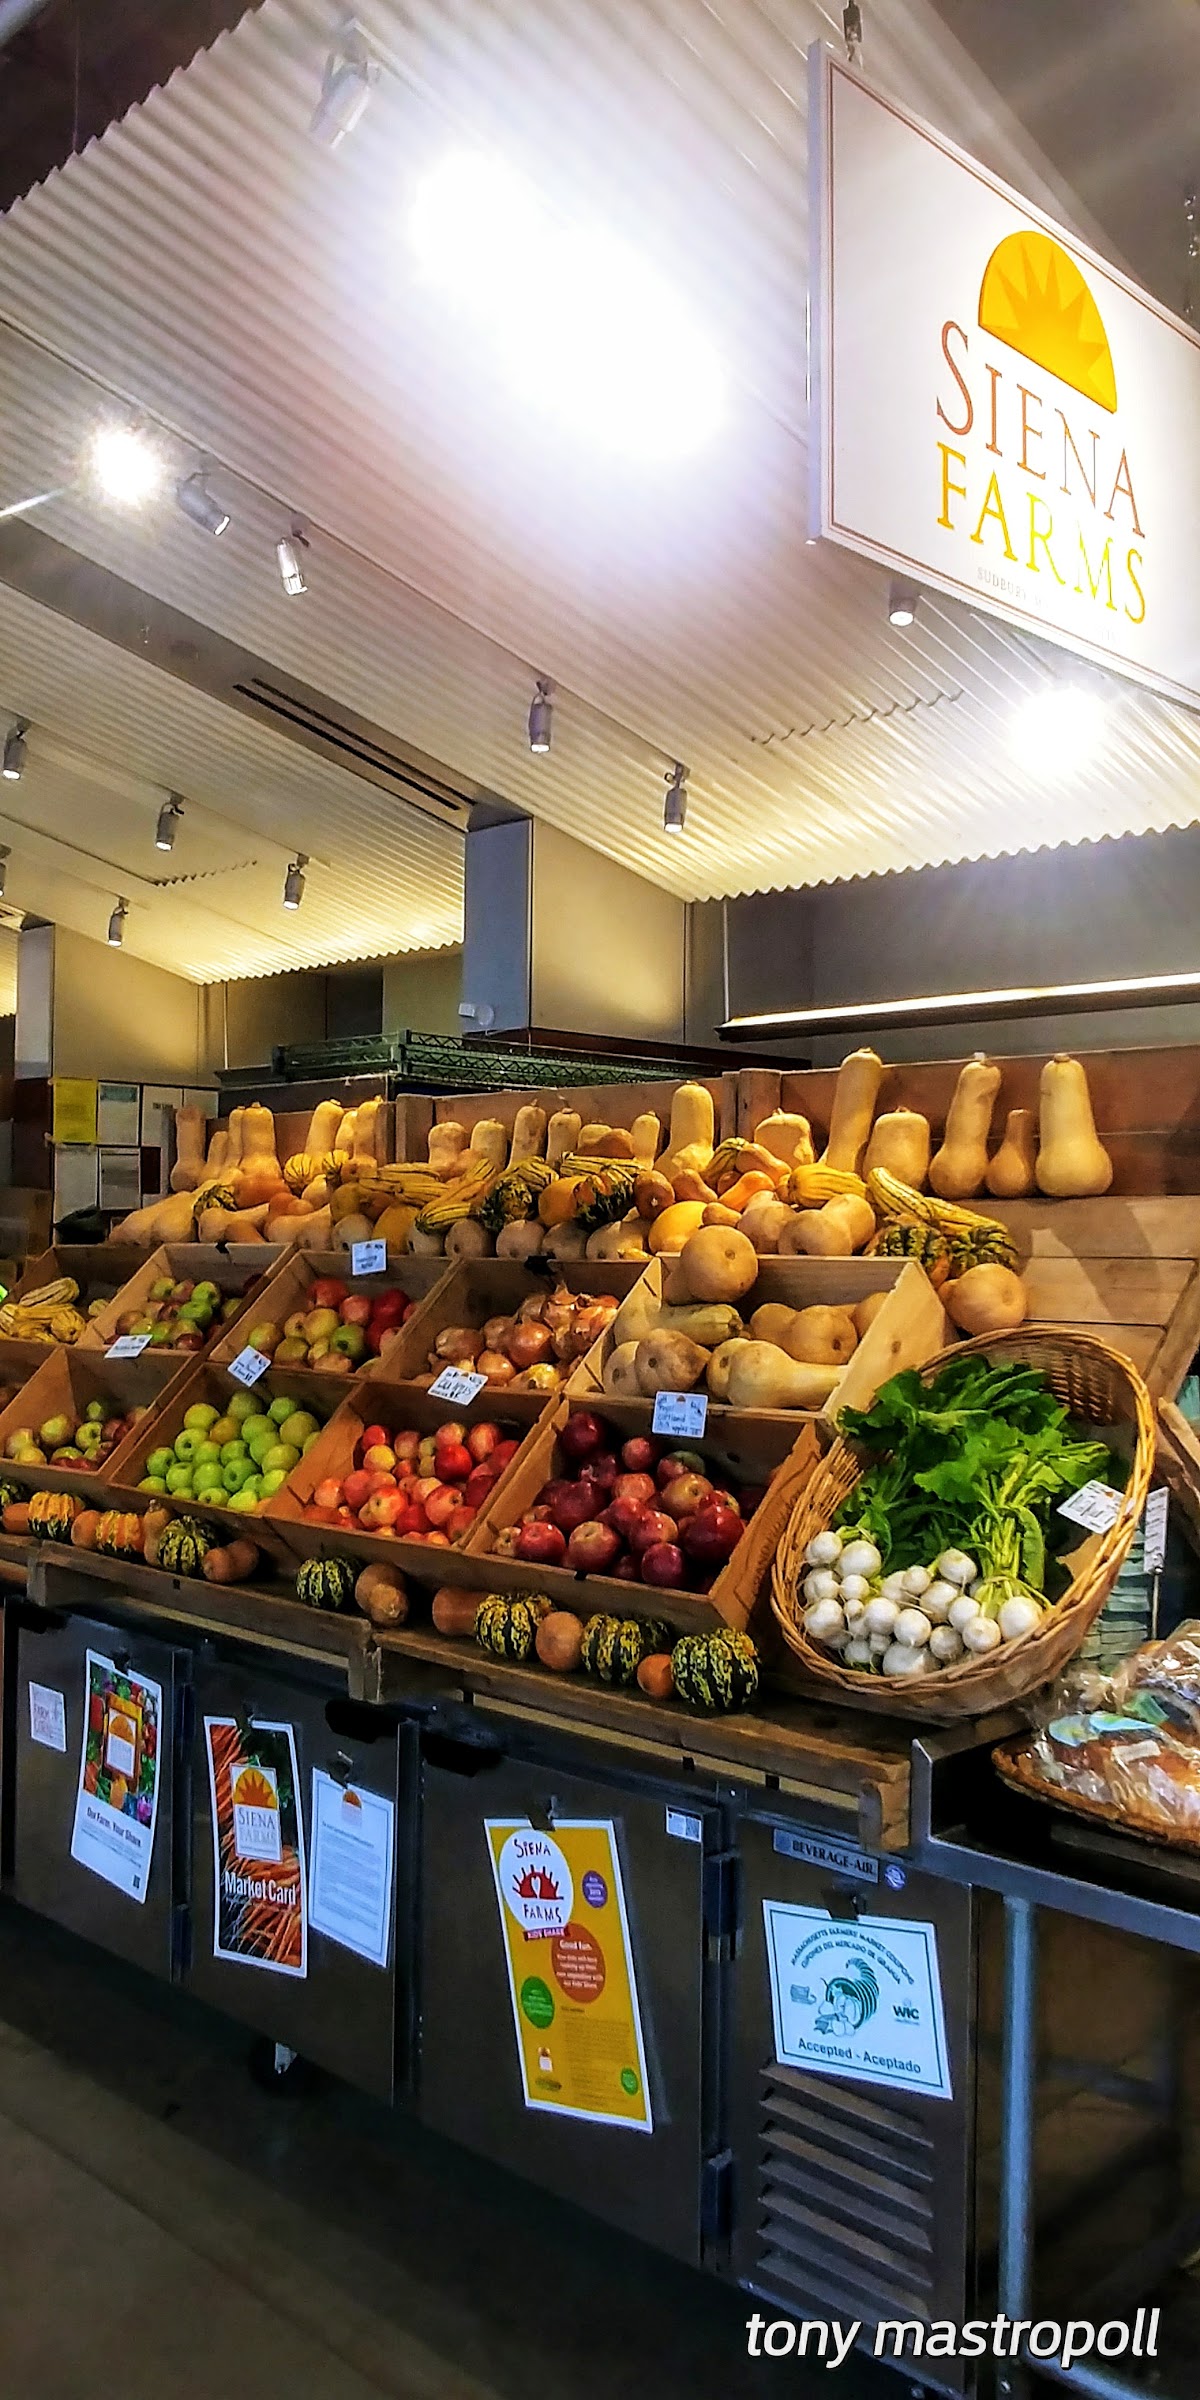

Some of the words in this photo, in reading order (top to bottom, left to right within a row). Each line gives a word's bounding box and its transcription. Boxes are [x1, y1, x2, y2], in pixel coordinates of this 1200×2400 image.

[937, 320, 1145, 538] SIENA
[937, 441, 1146, 624] FARMS
[239, 1807, 275, 1830] SIENA
[792, 1840, 873, 1875] BEVERAGE-AIR
[225, 1871, 266, 1898] Market
[268, 1879, 297, 1905] Card
[523, 1903, 562, 1923] FARMS
[892, 2004, 920, 2020] WIC
[798, 2037, 853, 2059] Accepted
[863, 2051, 922, 2074] Aceptado
